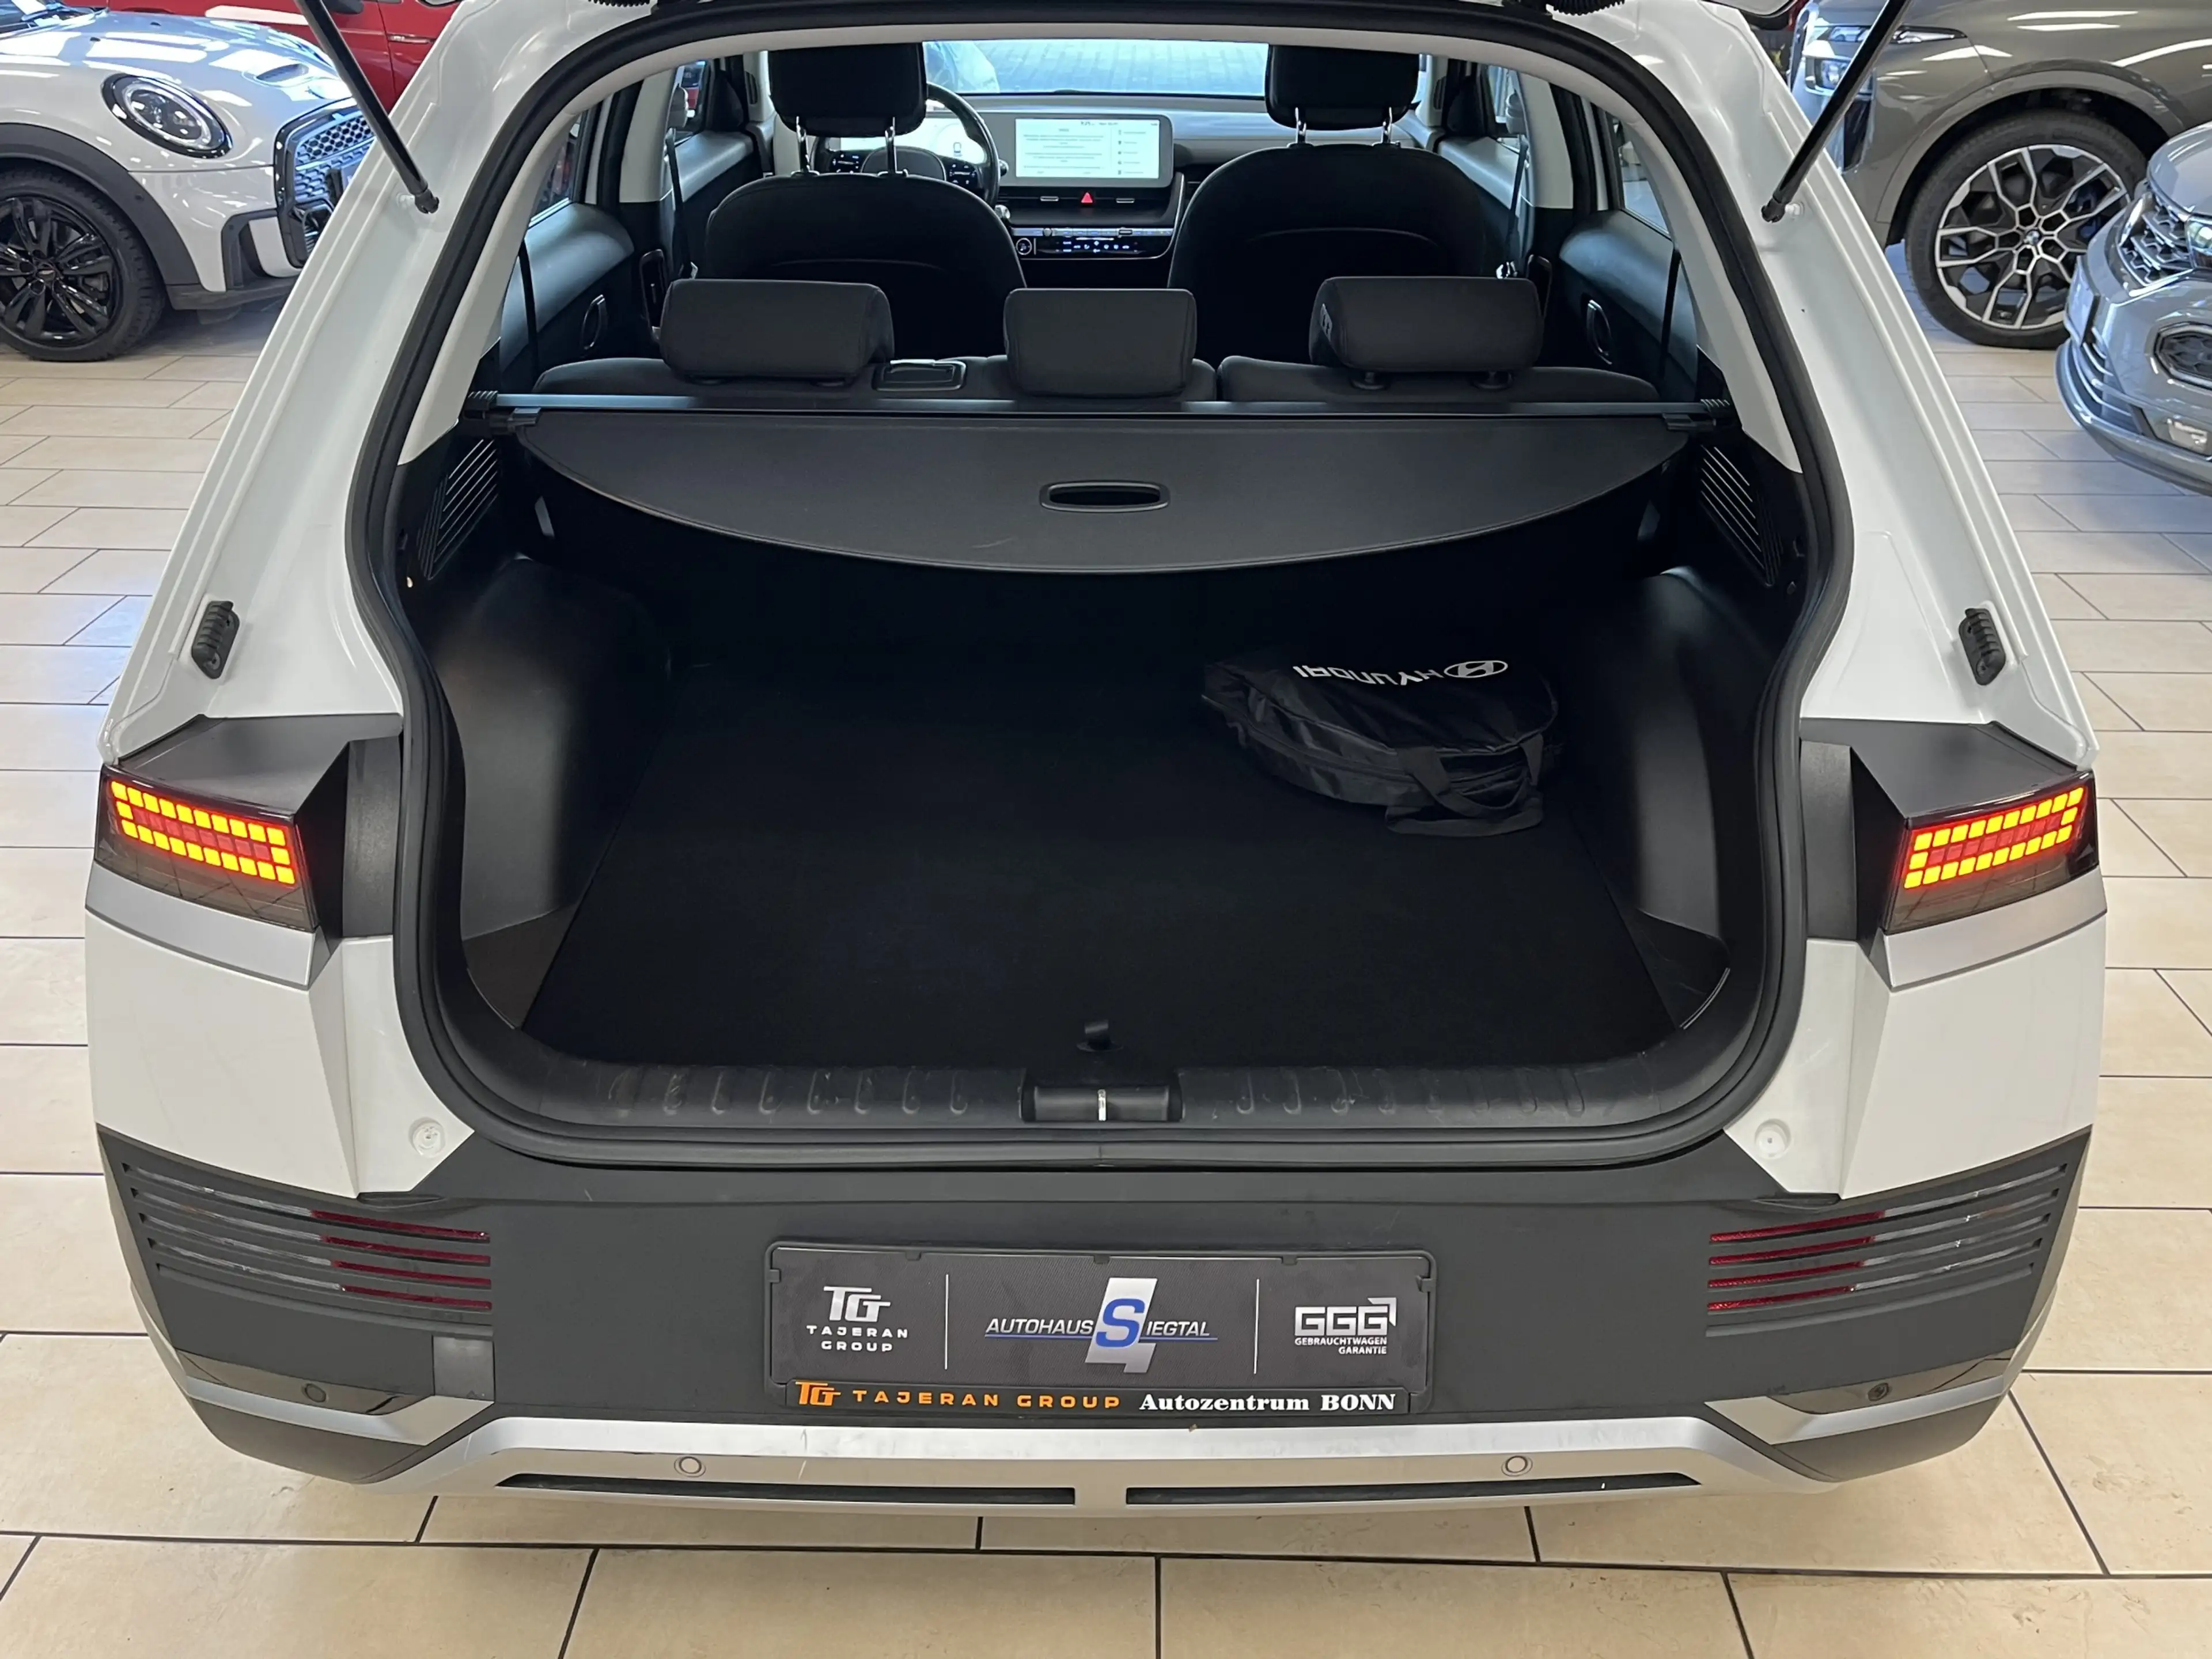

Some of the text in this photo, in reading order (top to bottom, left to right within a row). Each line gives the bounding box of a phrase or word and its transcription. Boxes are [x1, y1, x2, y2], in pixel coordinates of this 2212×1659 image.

[1293, 665, 1444, 685] HYUNDAI
[985, 1318, 1094, 1335] AUTOHAUS
[1295, 1305, 1388, 1336] GGG
[806, 1325, 908, 1338] TAJERAN
[821, 1340, 893, 1352] GROUP
[1294, 1336, 1387, 1346] GEBRAUCHTWAGEN
[1338, 1346, 1387, 1354] GARANTIE
[853, 1390, 999, 1407] TAJERAN
[1017, 1395, 1120, 1408] GROUP
[1139, 1393, 1309, 1411] Autozentrum
[1320, 1393, 1395, 1411] BONN
